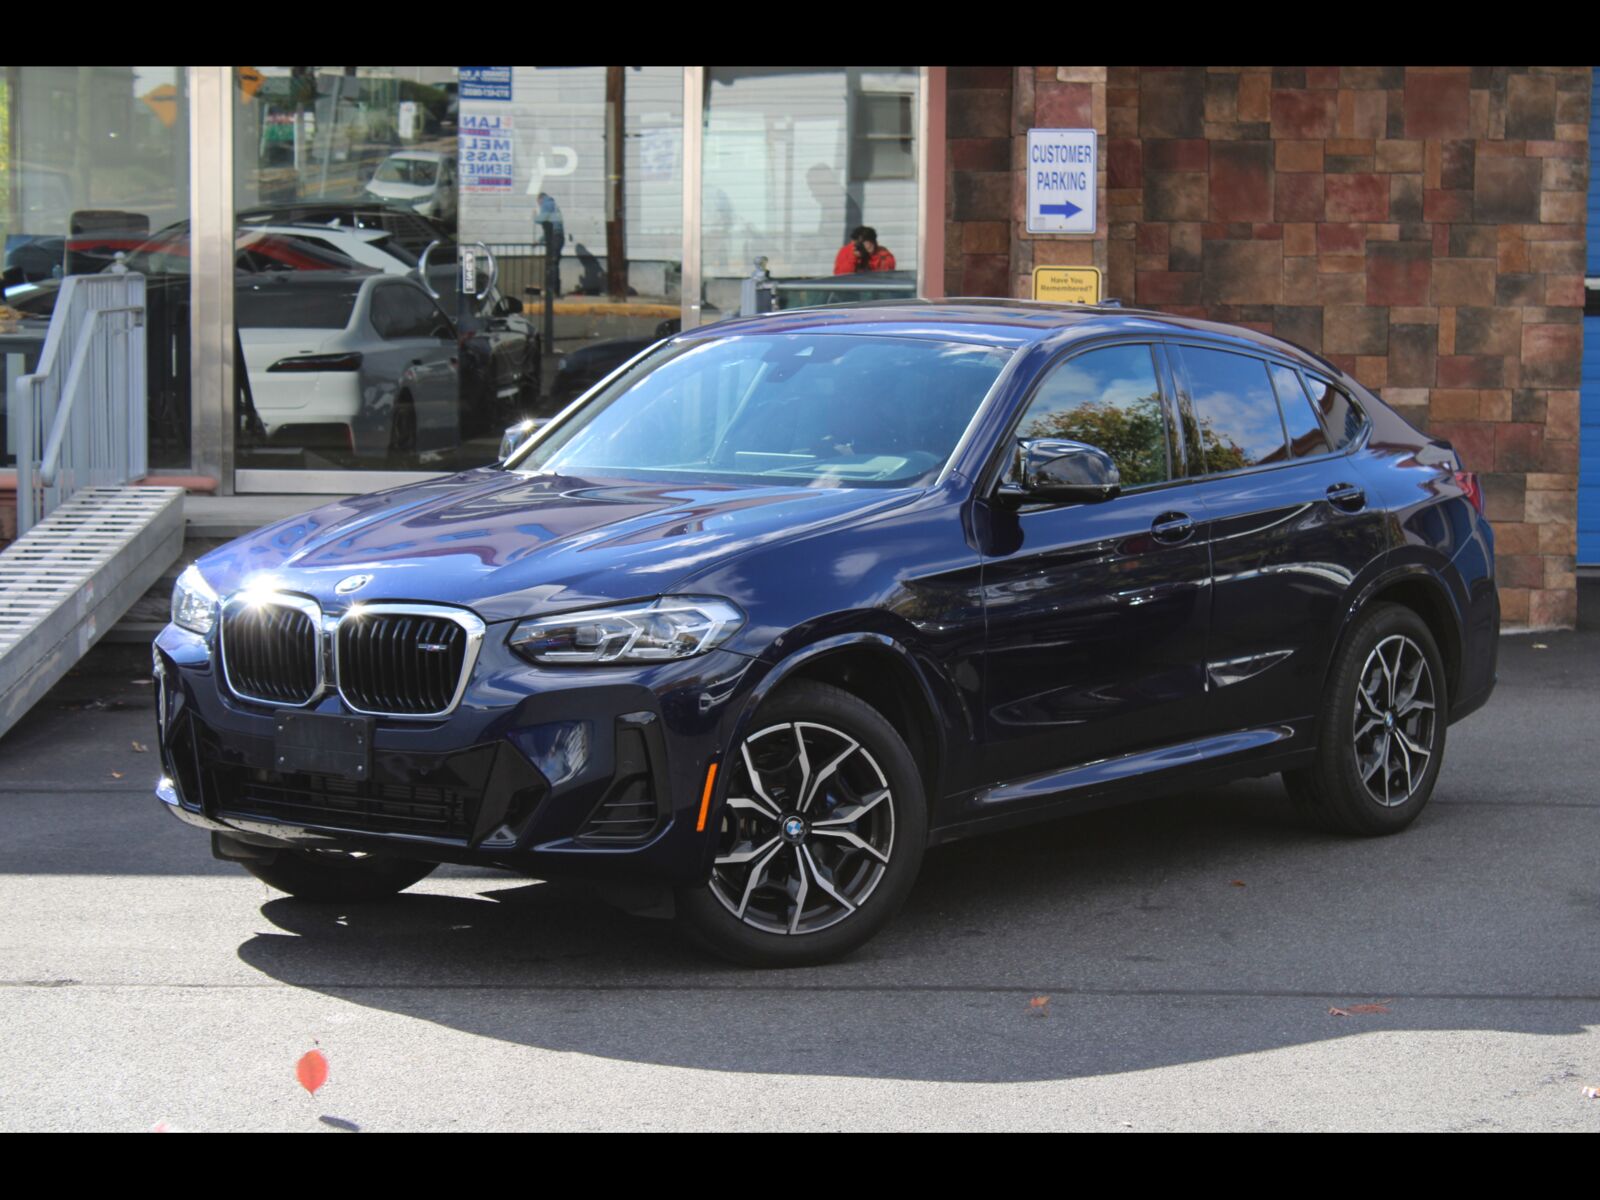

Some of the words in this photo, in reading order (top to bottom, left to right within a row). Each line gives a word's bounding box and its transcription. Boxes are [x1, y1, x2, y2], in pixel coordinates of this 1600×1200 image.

[1032, 144, 1092, 163] CUSTOMER
[1037, 171, 1087, 191] PARKING
[465, 252, 473, 290] PUSH
[1051, 276, 1069, 284] Have
[1041, 284, 1093, 292] Remembered?
